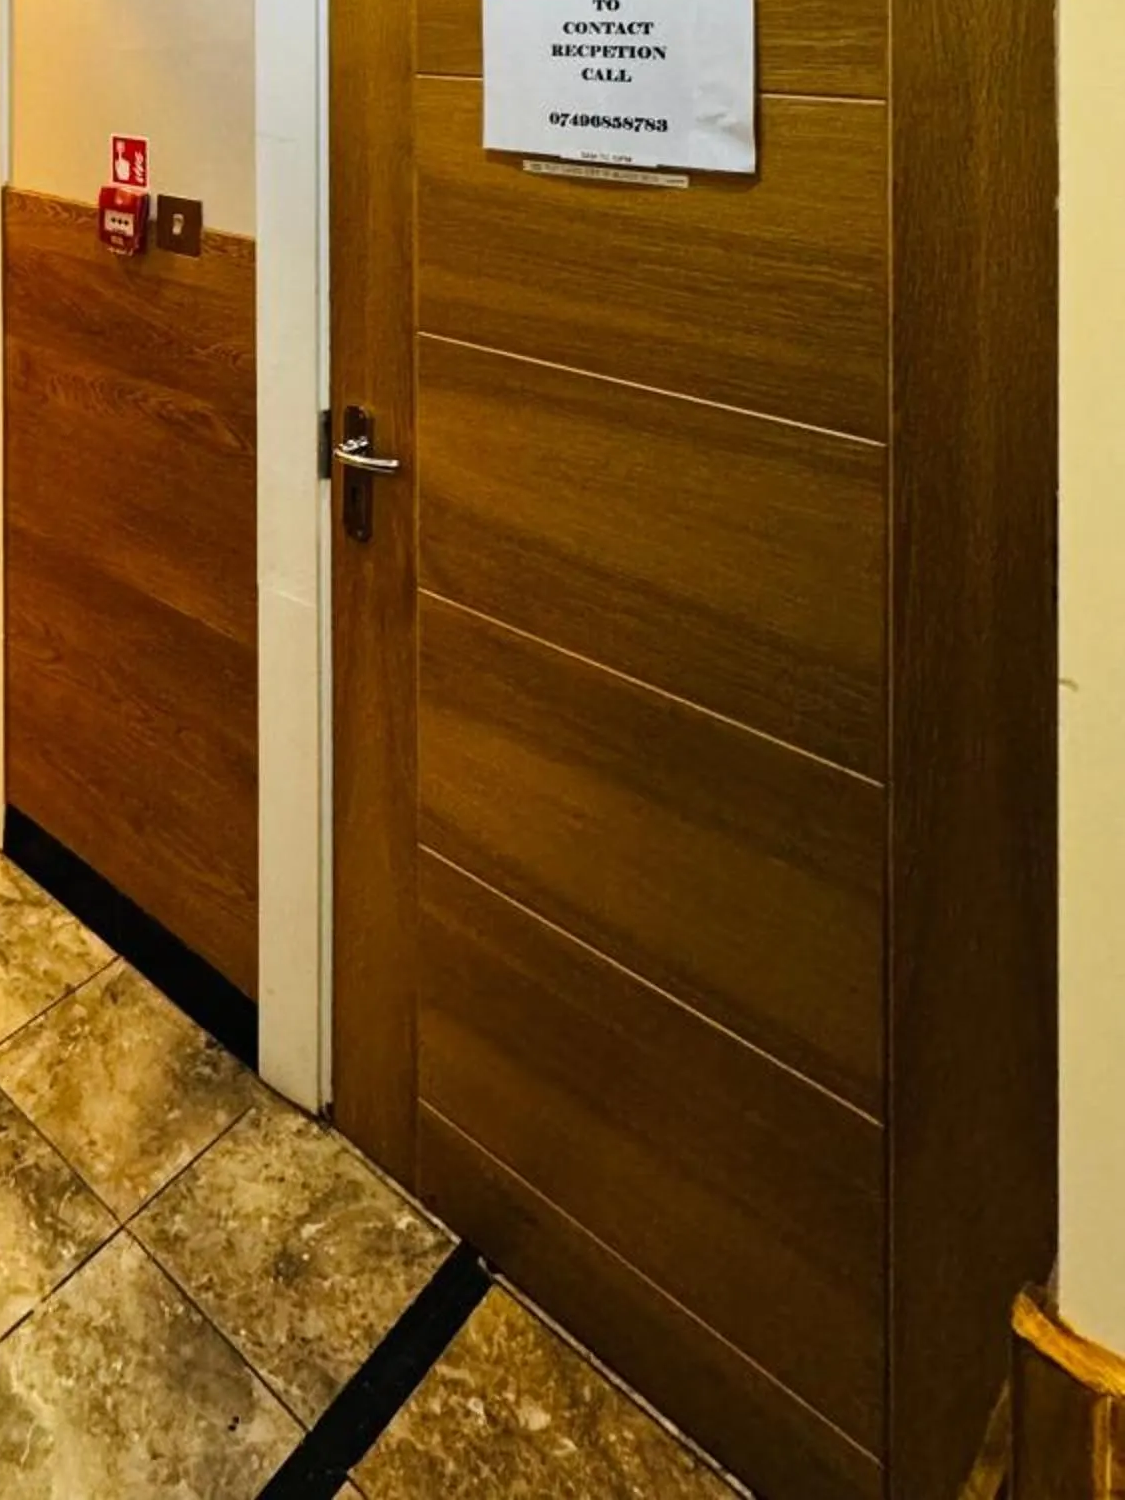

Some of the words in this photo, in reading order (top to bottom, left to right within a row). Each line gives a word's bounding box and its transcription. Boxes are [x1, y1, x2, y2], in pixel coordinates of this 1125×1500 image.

[563, 21, 654, 36] CONTACT
[551, 43, 667, 60] RECPETION
[581, 67, 632, 83] CALL
